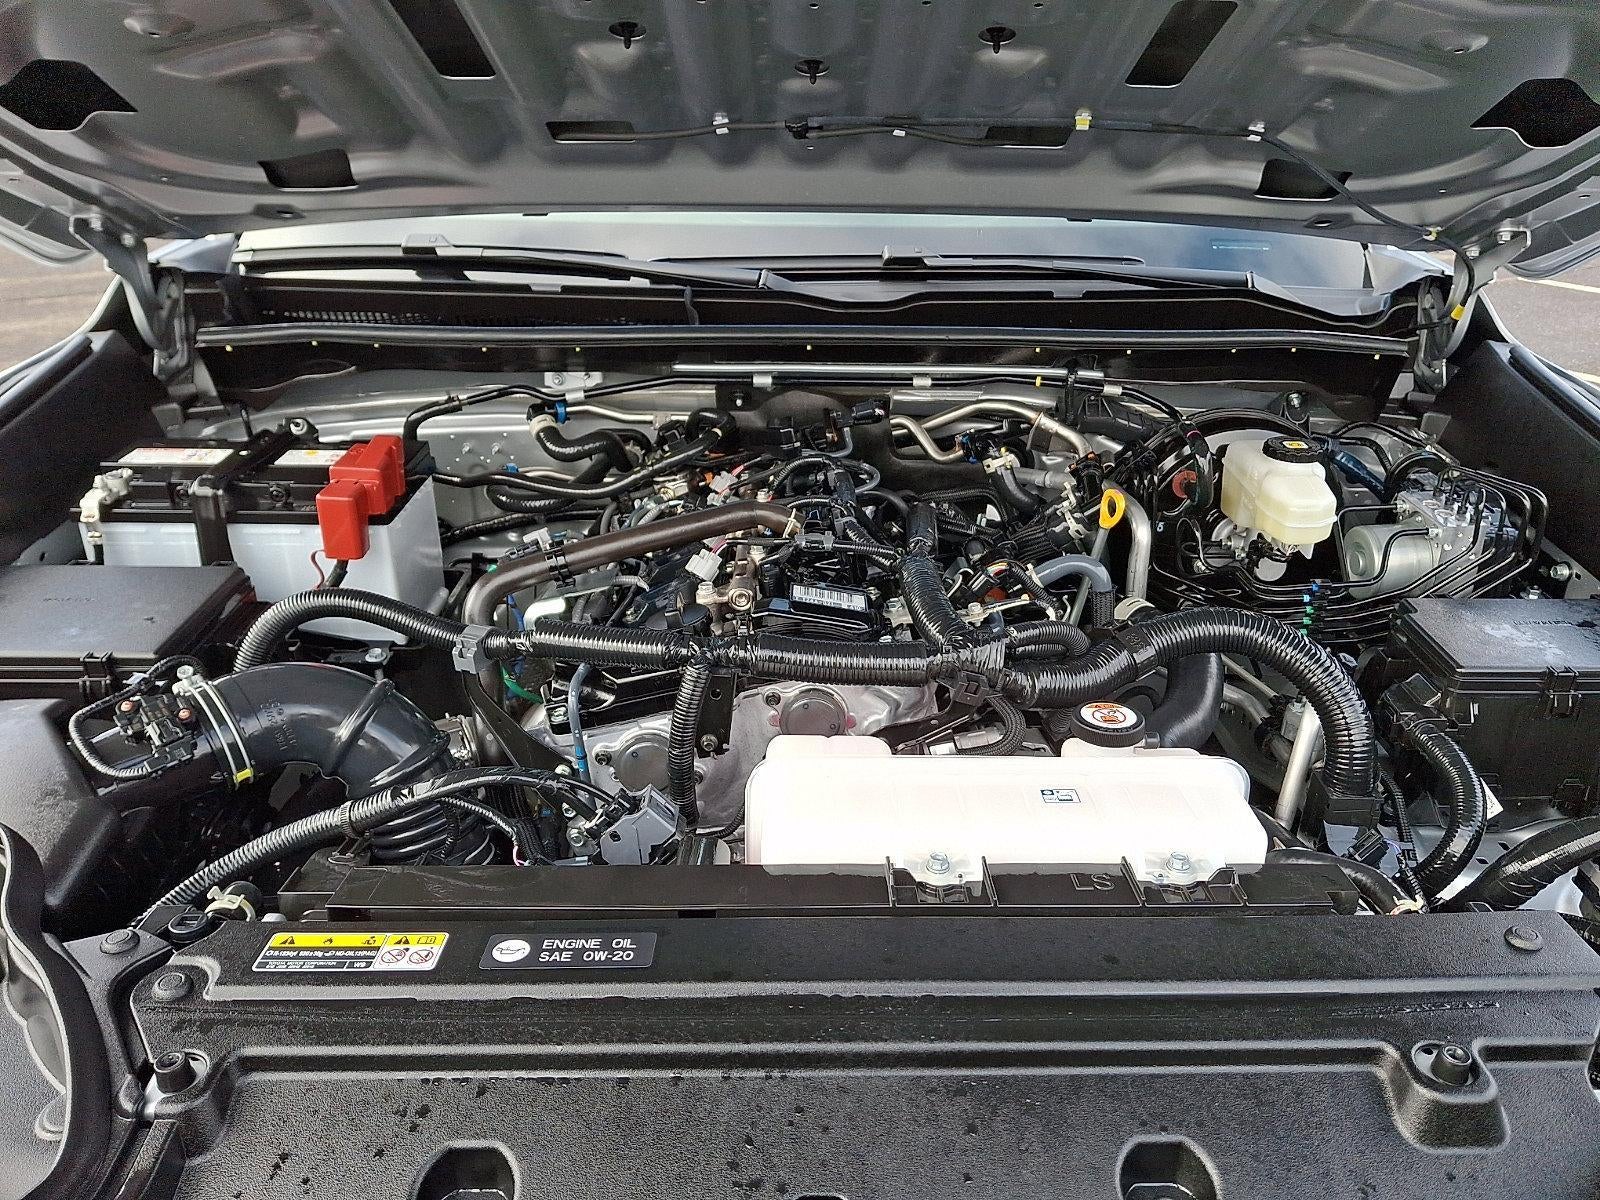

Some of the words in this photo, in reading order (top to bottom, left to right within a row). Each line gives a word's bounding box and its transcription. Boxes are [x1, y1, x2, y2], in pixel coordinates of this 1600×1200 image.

[1069, 872, 1116, 891] LS
[542, 938, 602, 949] ENGINE
[611, 938, 637, 949] OIL
[538, 951, 574, 961] SAE
[583, 951, 634, 961] 0W-20
